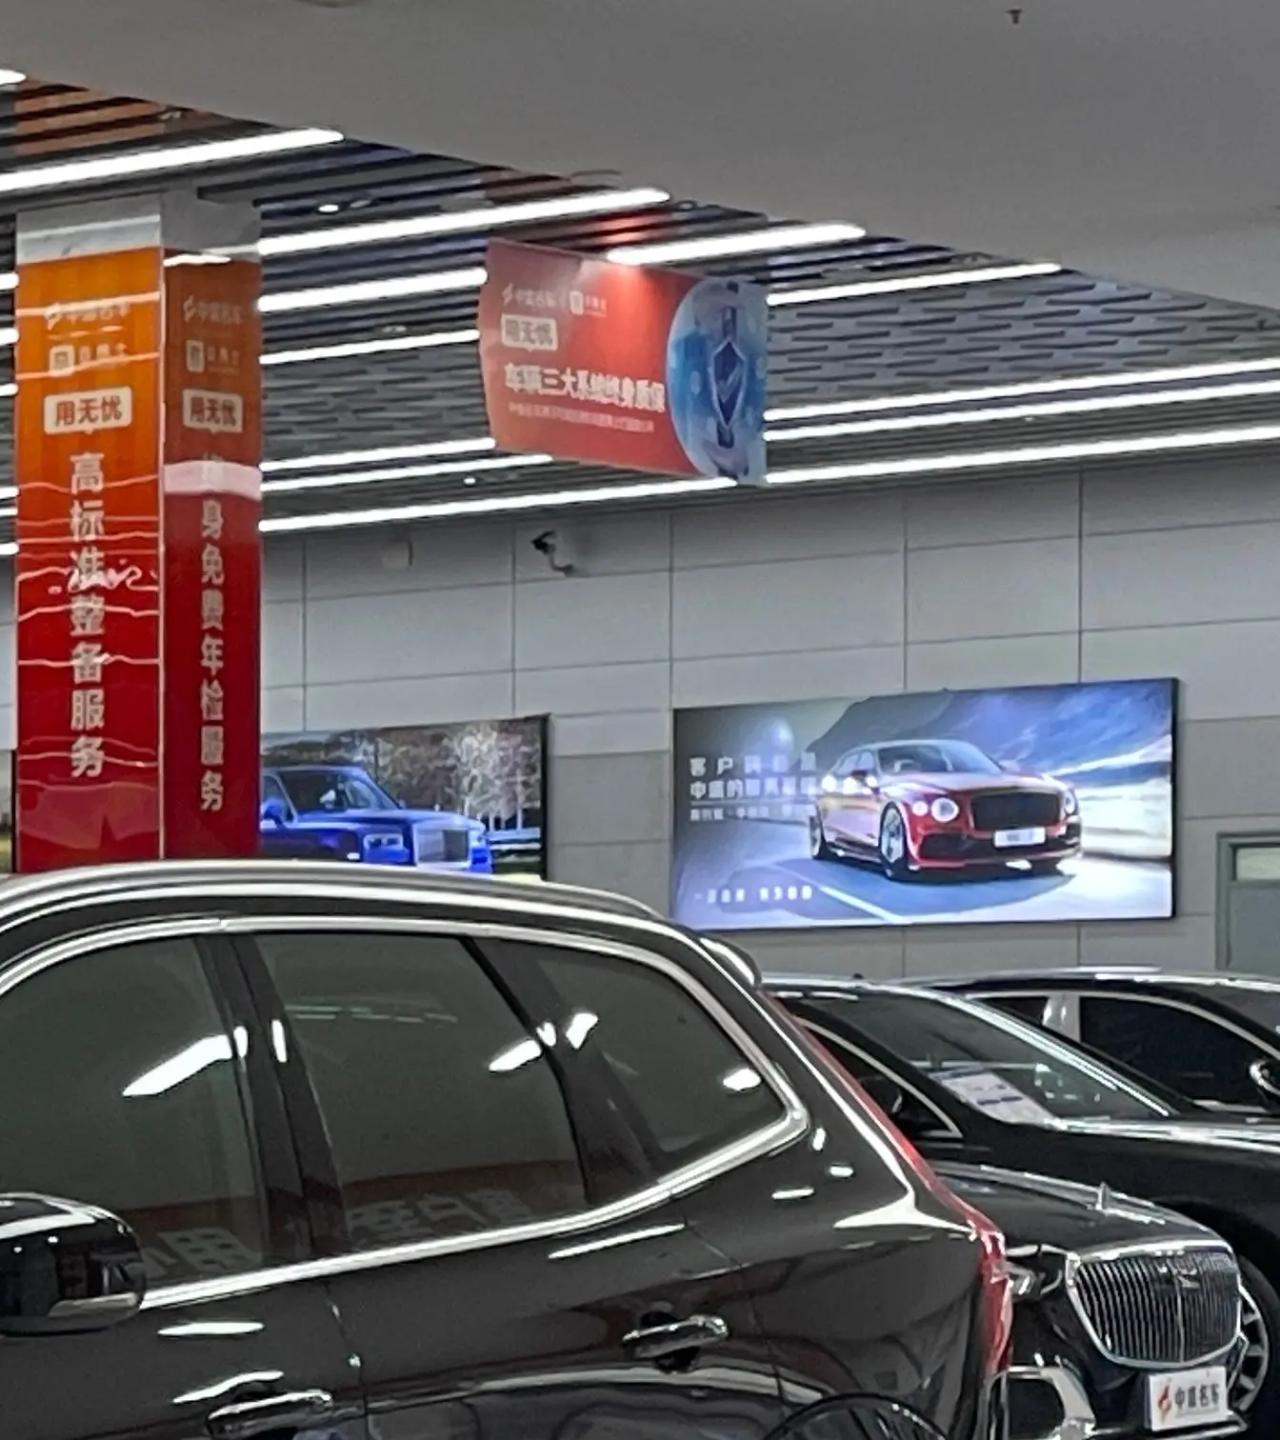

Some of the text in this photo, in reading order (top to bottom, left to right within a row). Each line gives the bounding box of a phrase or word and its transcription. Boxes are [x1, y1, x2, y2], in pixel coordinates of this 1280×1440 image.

[56, 396, 123, 427] 用无忧
[200, 452, 225, 811] 身免费年检服务
